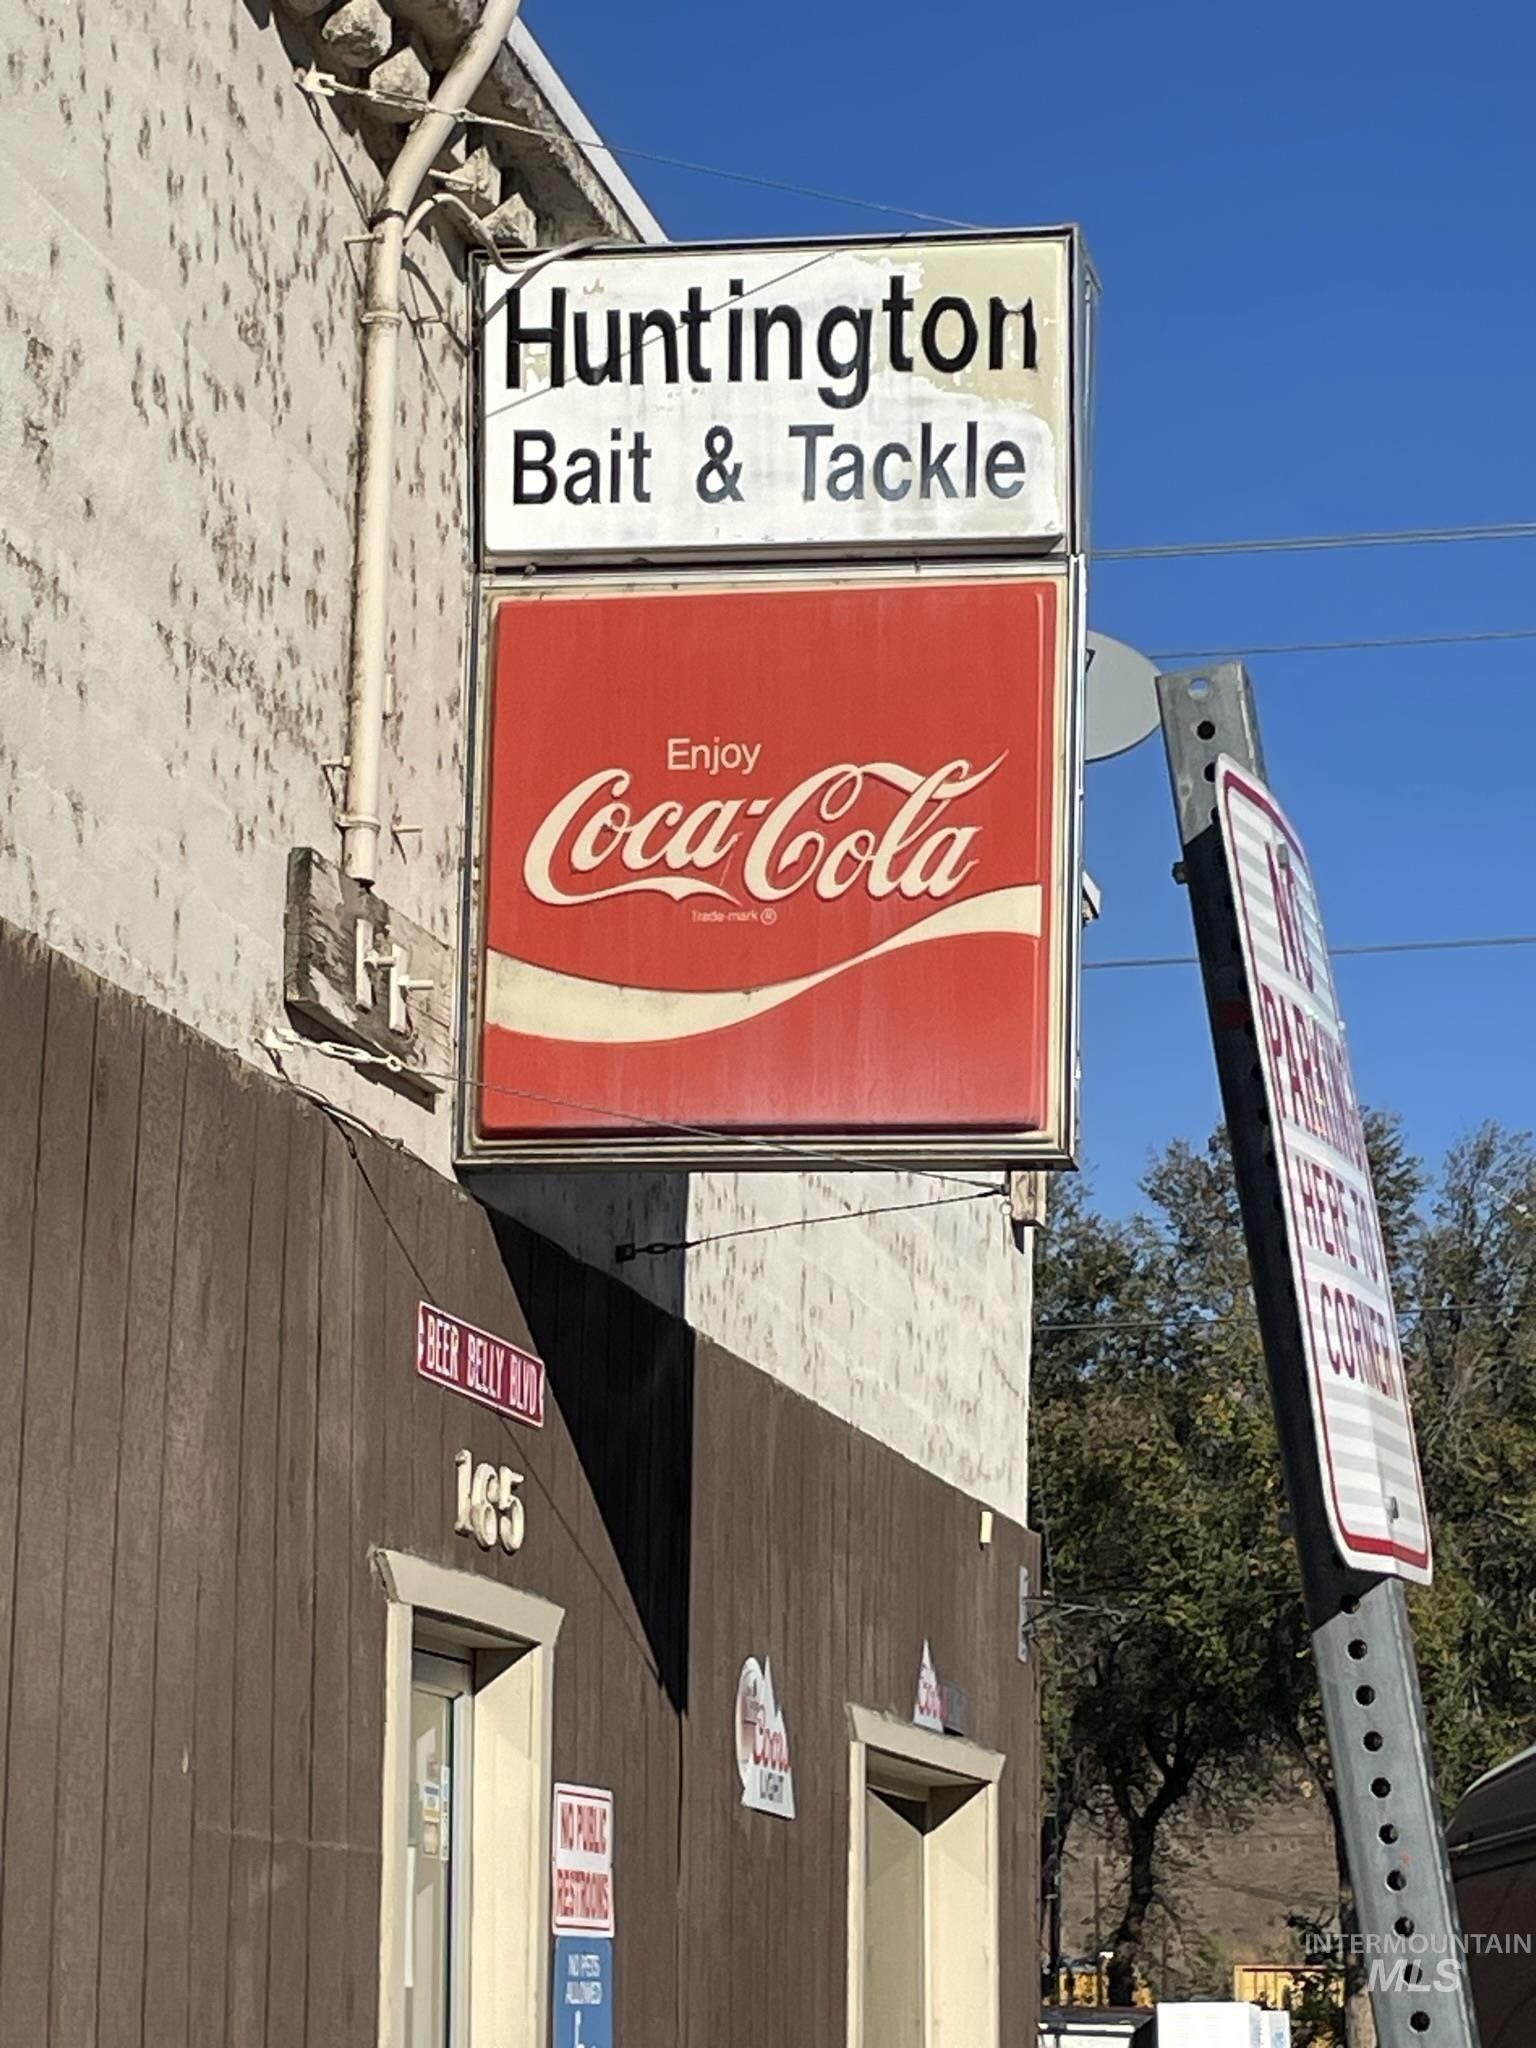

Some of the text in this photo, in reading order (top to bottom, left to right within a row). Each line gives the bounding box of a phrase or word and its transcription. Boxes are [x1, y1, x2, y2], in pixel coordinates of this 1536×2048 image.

[505, 275, 1038, 409] Huntington
[512, 421, 1026, 506] Bait & Tackle
[666, 736, 762, 775] Enjoy
[523, 748, 1009, 906] Coca-Cola
[1295, 1153, 1358, 1270] HERE
[426, 1313, 538, 1416] BEER BELLY BLVD
[454, 1448, 525, 1552] 165
[560, 1801, 607, 1855] NO PUBLIC
